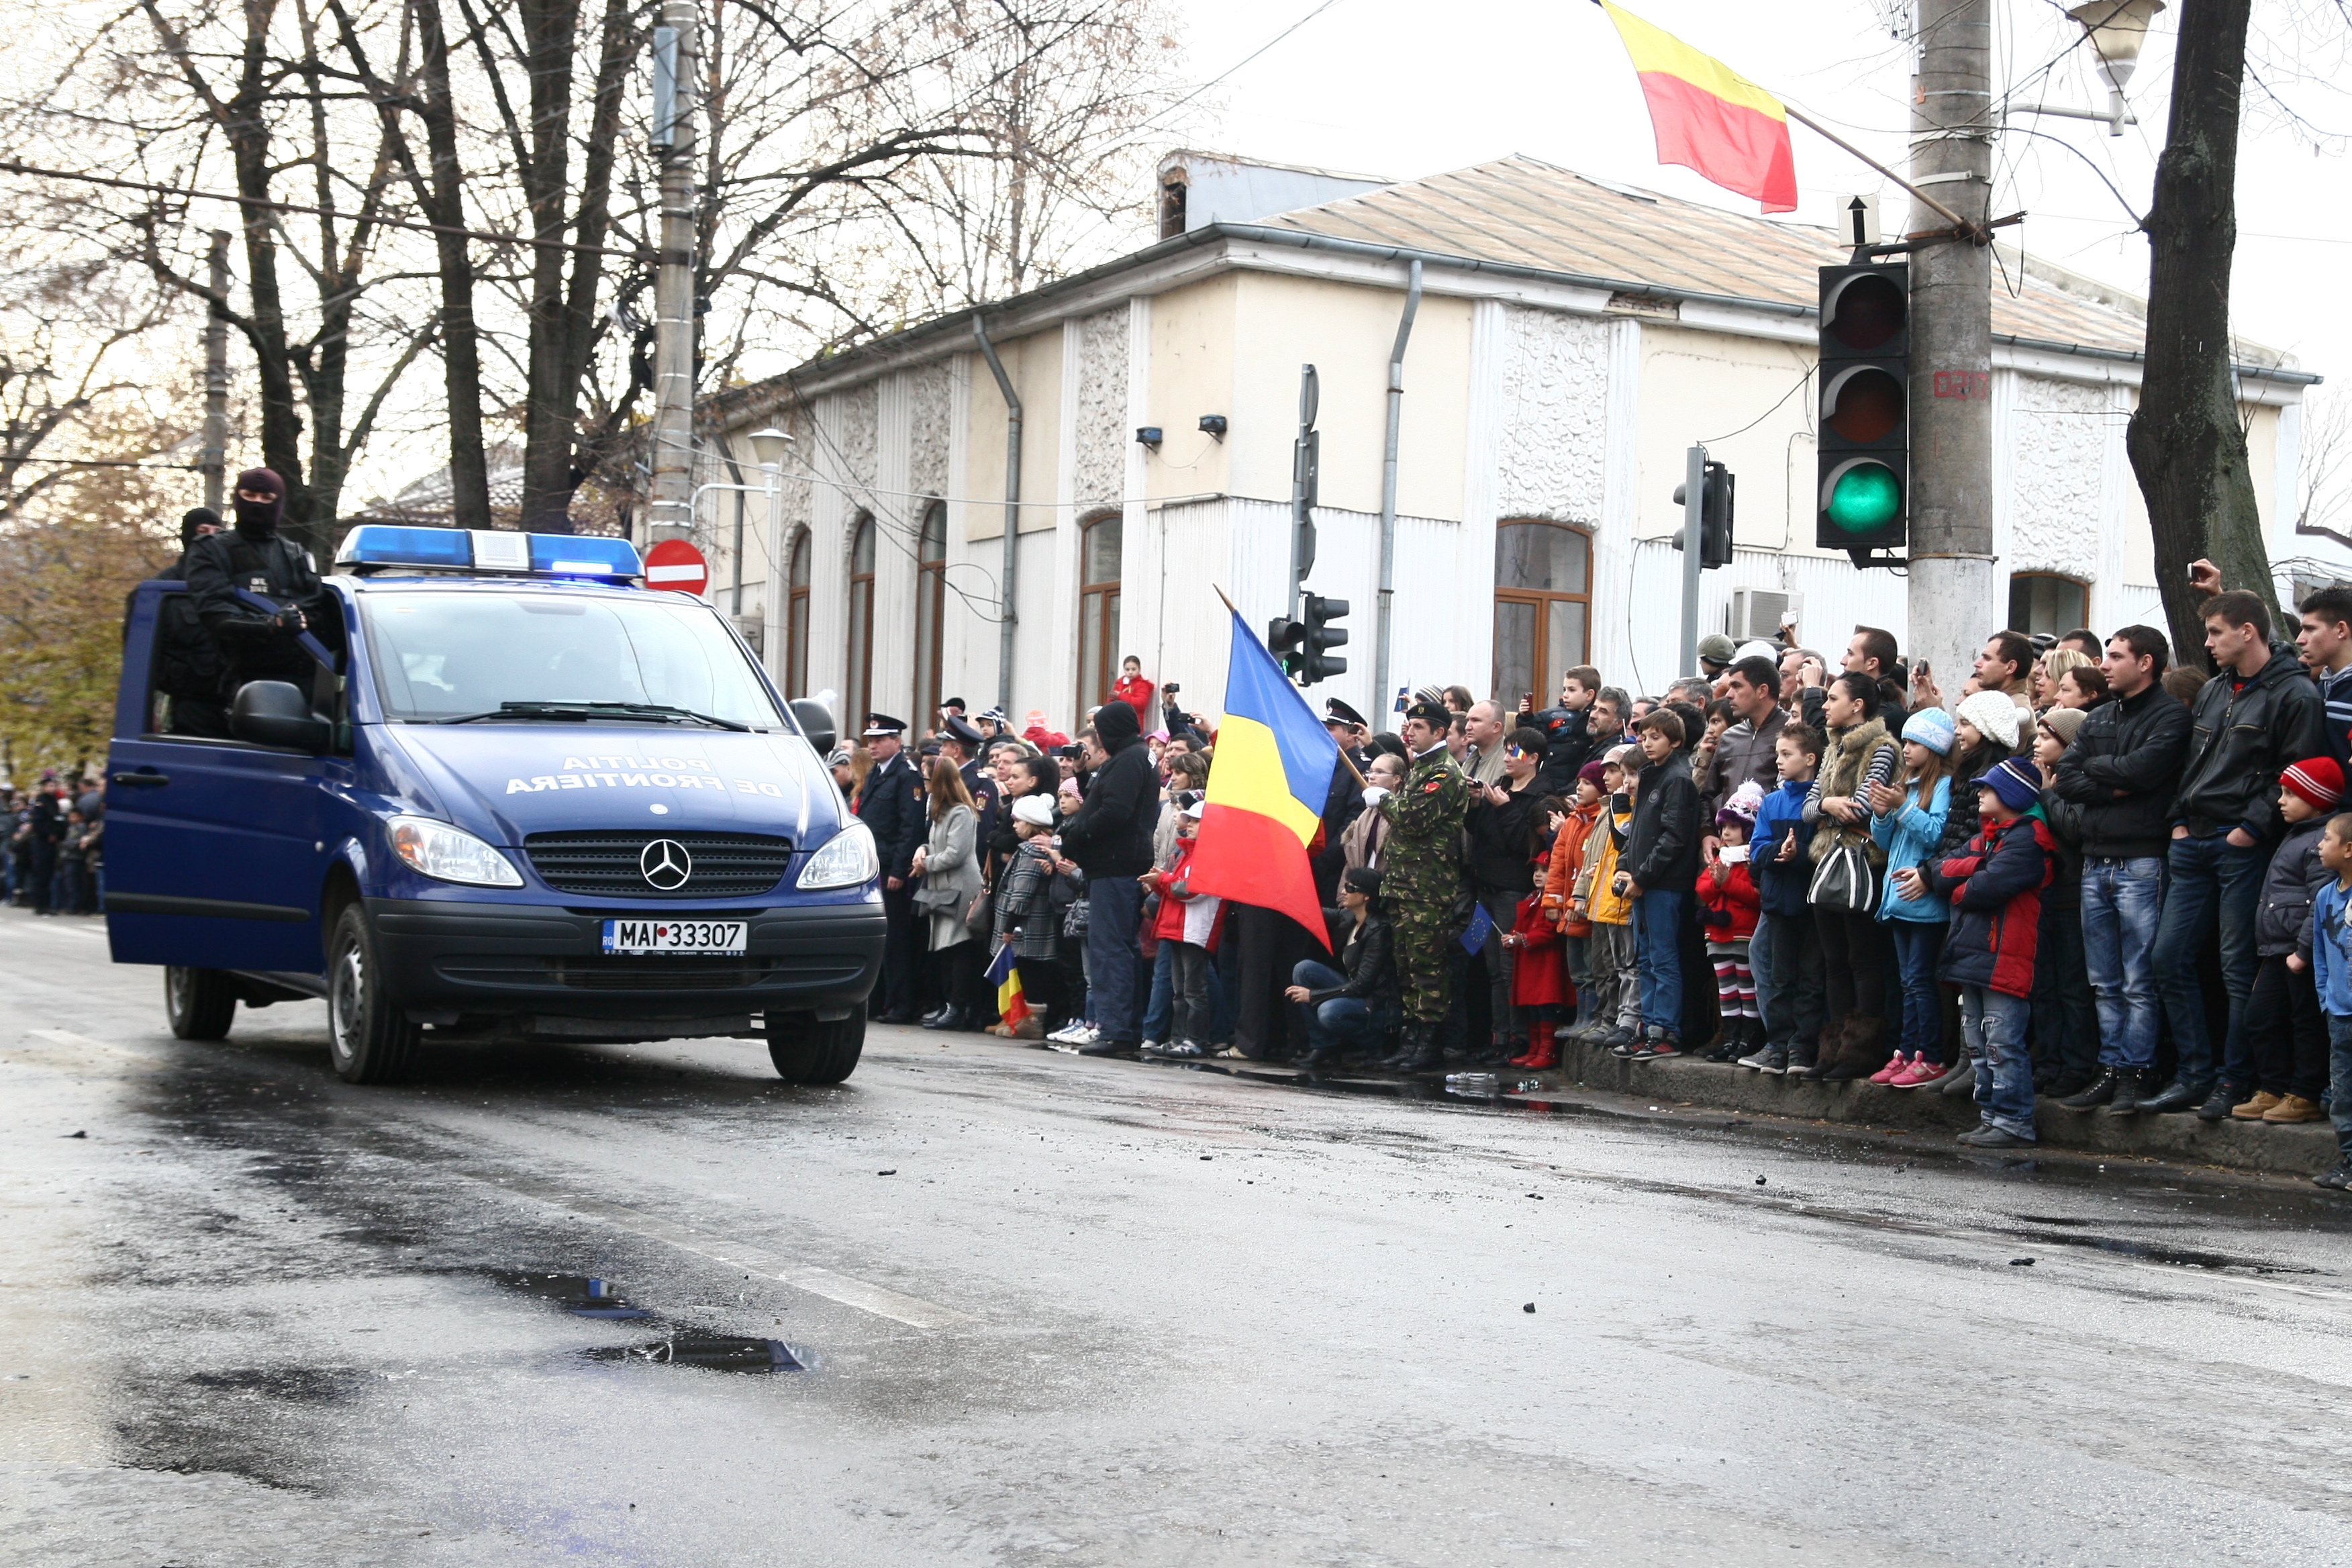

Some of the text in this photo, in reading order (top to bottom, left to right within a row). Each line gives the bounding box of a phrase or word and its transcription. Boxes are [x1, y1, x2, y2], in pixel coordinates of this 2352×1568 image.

[602, 936, 614, 946] RO
[620, 922, 740, 948] MAI 33307
